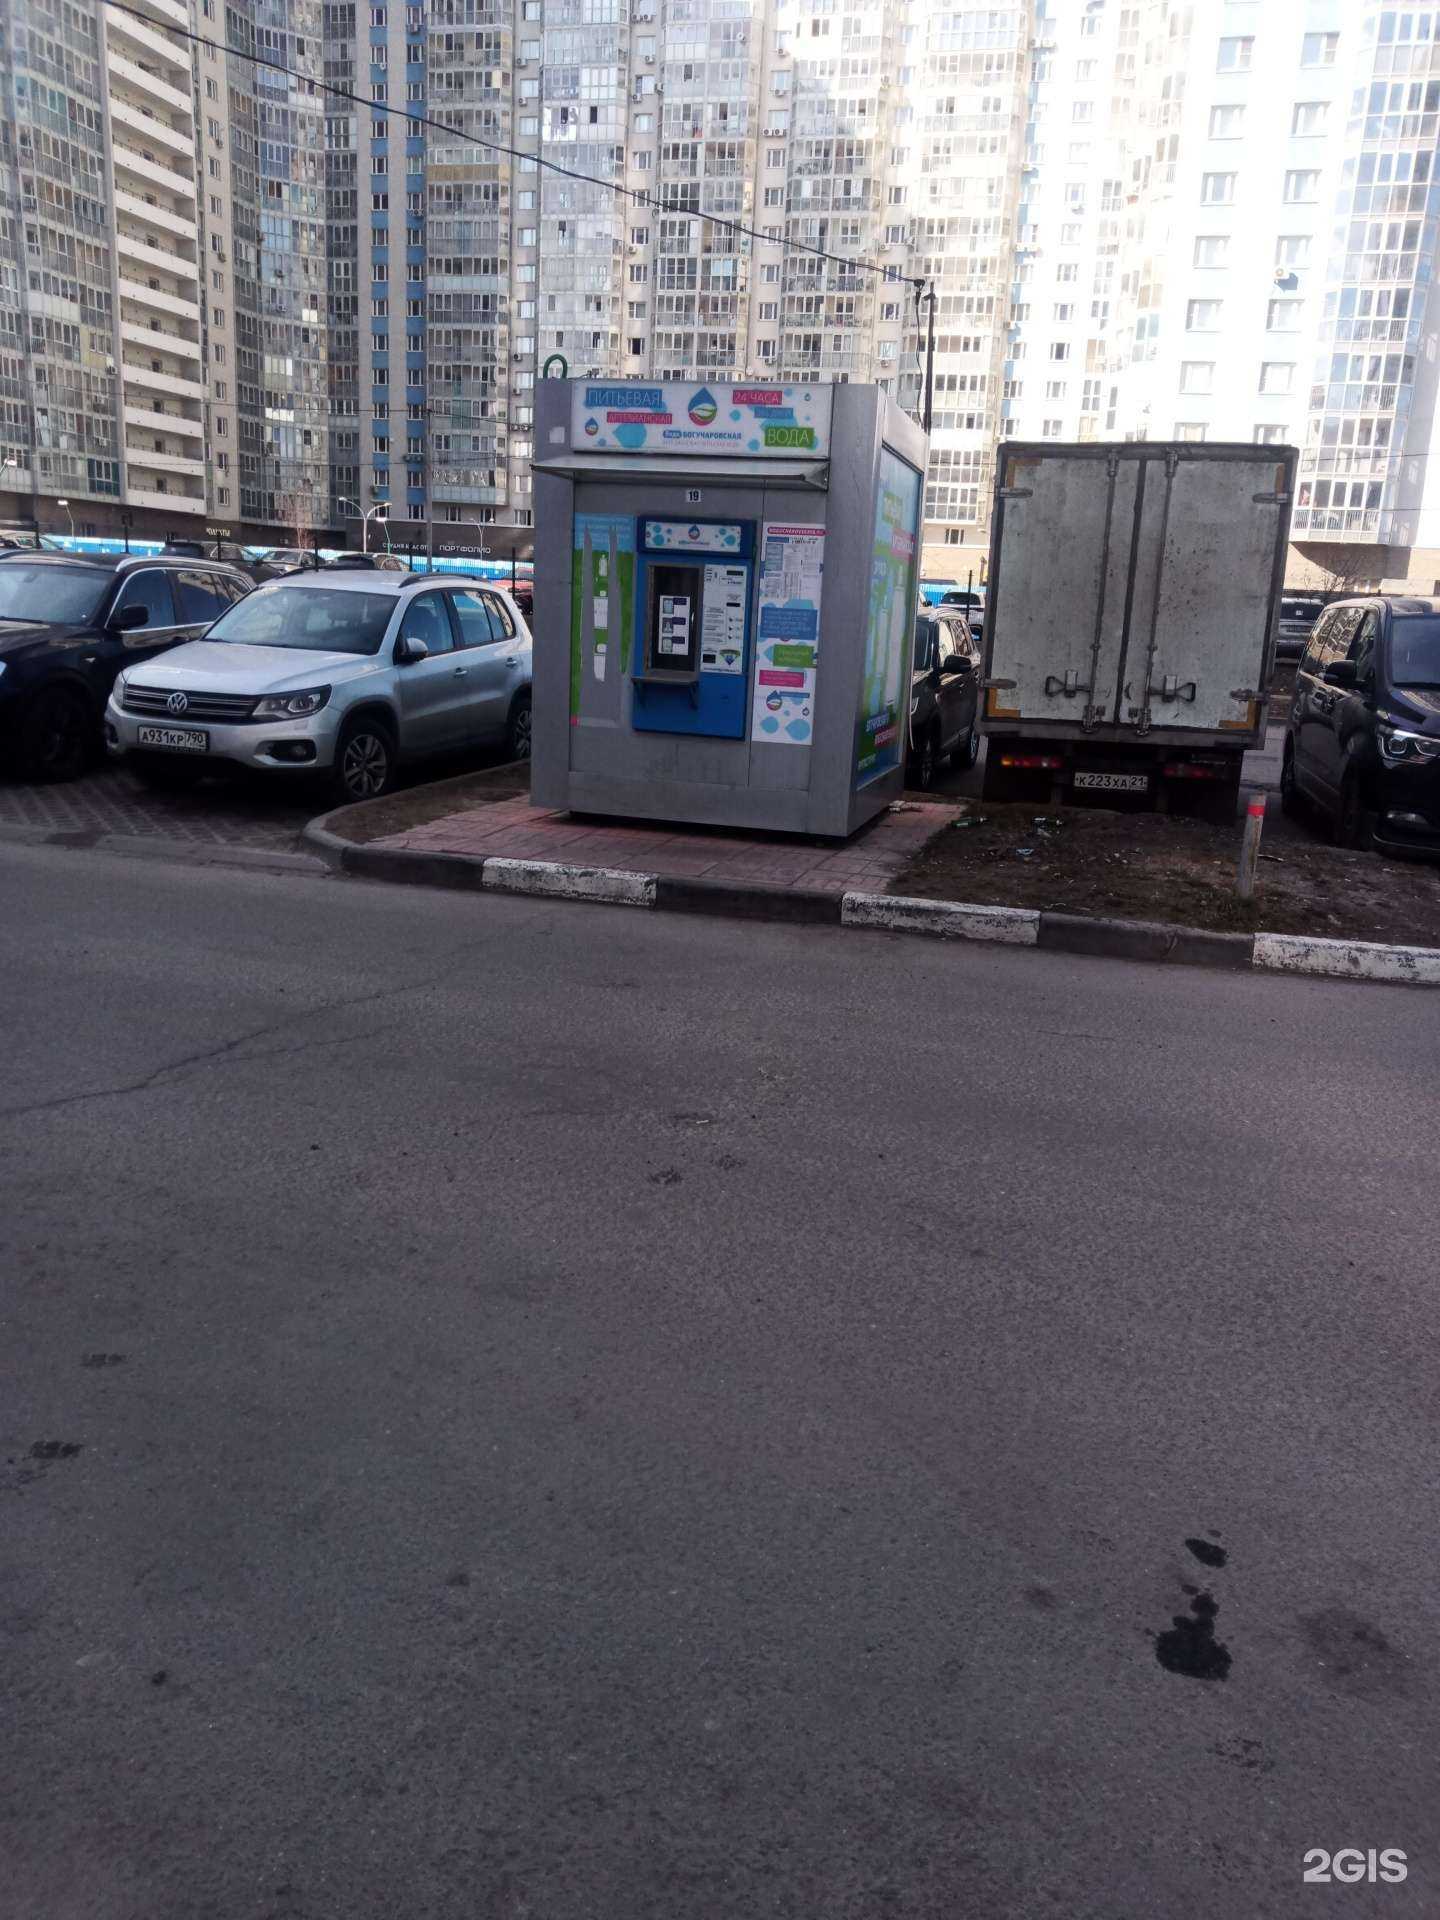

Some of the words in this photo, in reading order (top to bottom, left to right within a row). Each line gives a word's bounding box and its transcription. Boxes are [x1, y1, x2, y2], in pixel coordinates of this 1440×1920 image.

[588, 390, 660, 407] ПИТЬЕВАЯ
[735, 392, 747, 403] 24
[750, 393, 779, 404] ЧАСА
[768, 428, 809, 446] ВОДА
[688, 490, 700, 501] 19
[440, 544, 491, 554] ПОРТФОЛИО
[142, 729, 184, 745] А931КР
[1079, 774, 1127, 788] К223ХА
[1130, 776, 1144, 786] 21
